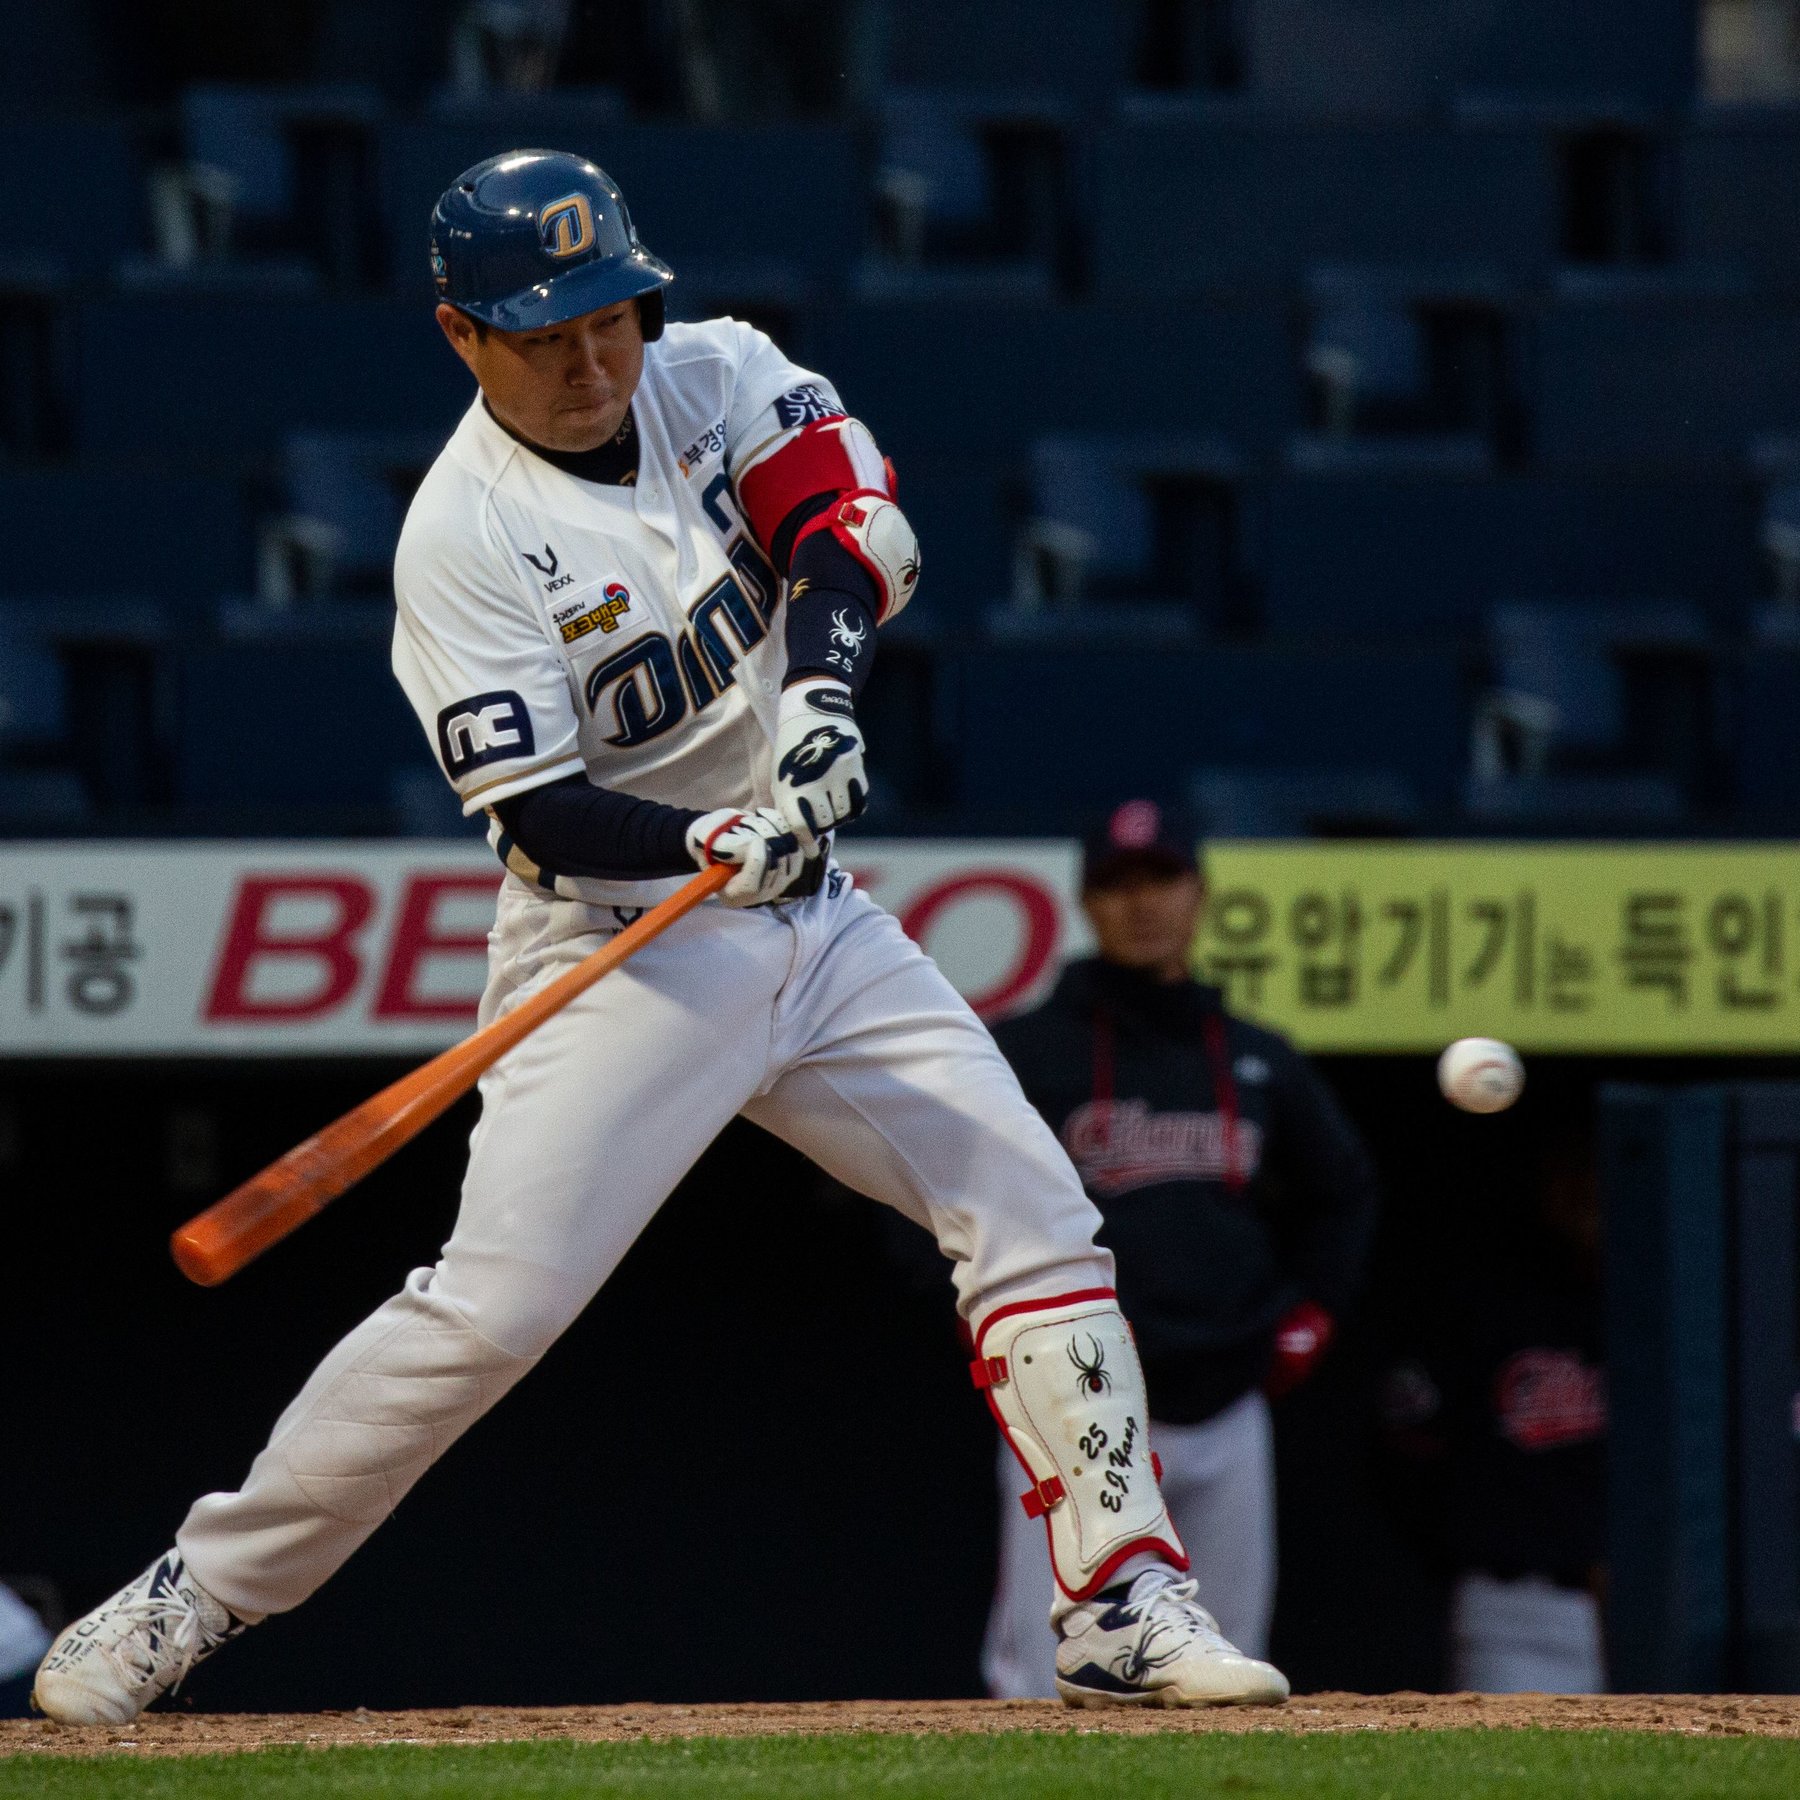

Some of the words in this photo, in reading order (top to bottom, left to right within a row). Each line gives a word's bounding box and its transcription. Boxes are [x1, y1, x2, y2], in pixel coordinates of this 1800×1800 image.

[543, 573, 575, 593] VEXX
[559, 596, 631, 644] 포크밸리
[825, 649, 854, 673] 25
[1203, 887, 1594, 1013] 유압기기는
[1079, 1422, 1108, 1460] 25
